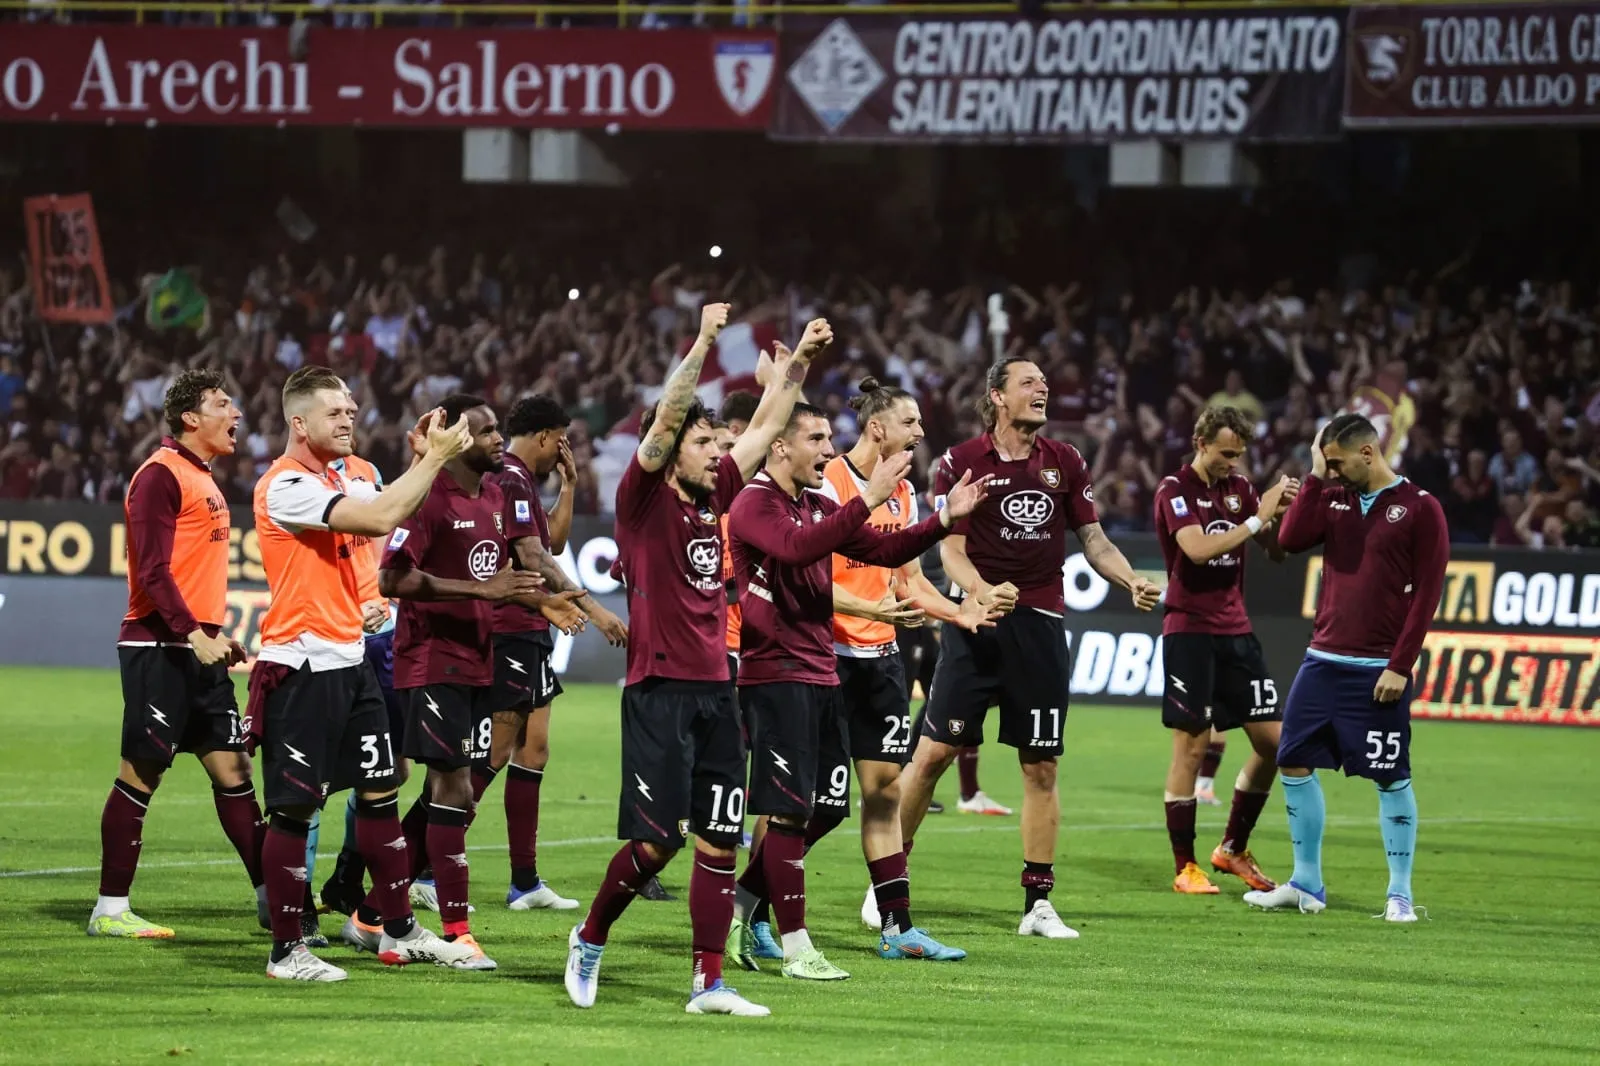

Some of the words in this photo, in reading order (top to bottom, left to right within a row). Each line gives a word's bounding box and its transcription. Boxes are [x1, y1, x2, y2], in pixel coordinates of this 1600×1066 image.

[893, 20, 1034, 75] CENTRO
[1035, 16, 1339, 75] COORDINAMENTO
[1421, 16, 1560, 66] TORRACA
[72, 37, 311, 115] Arechi
[392, 39, 675, 118] Salerno
[1411, 75, 1488, 108] CLUB
[1495, 73, 1577, 107] ALDO
[889, 78, 1127, 134] SALERNITANA
[1132, 77, 1250, 134] CLUBS
[0, 520, 94, 575] RO
[1250, 678, 1278, 707] 15
[1030, 708, 1060, 739] 11
[1250, 706, 1276, 716] Zeus
[882, 715, 911, 746] 25
[1029, 738, 1059, 747] Zeus
[1365, 730, 1401, 761] 55
[360, 732, 394, 769] 31
[1369, 760, 1396, 769] Zeus
[365, 768, 395, 778] Zeus
[828, 764, 848, 798] 9
[711, 784, 744, 824] 10
[817, 795, 847, 807] Zeus
[707, 821, 740, 833] Zeus
